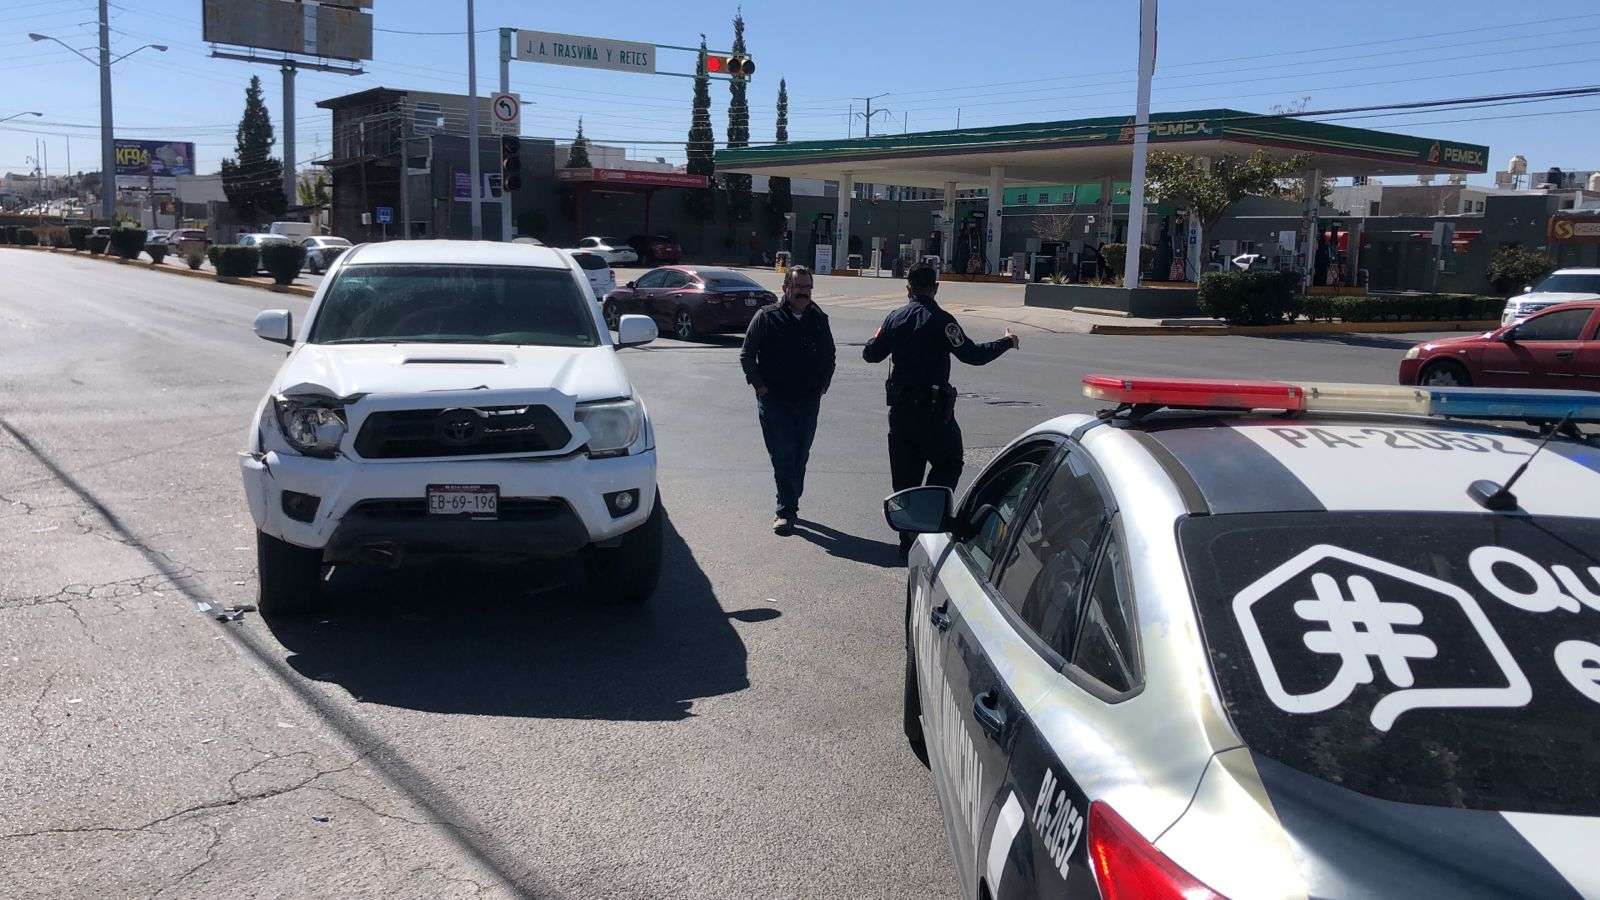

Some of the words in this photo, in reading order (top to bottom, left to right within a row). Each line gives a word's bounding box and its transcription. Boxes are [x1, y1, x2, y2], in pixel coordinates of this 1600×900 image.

[553, 43, 598, 60] TRASVIÑA
[606, 49, 613, 62] Y
[619, 51, 648, 66] RETES
[115, 148, 149, 166] KF94
[1443, 147, 1482, 163] PEMEX
[1267, 427, 1530, 455] PA-2052
[1032, 767, 1083, 881] PA-2052
